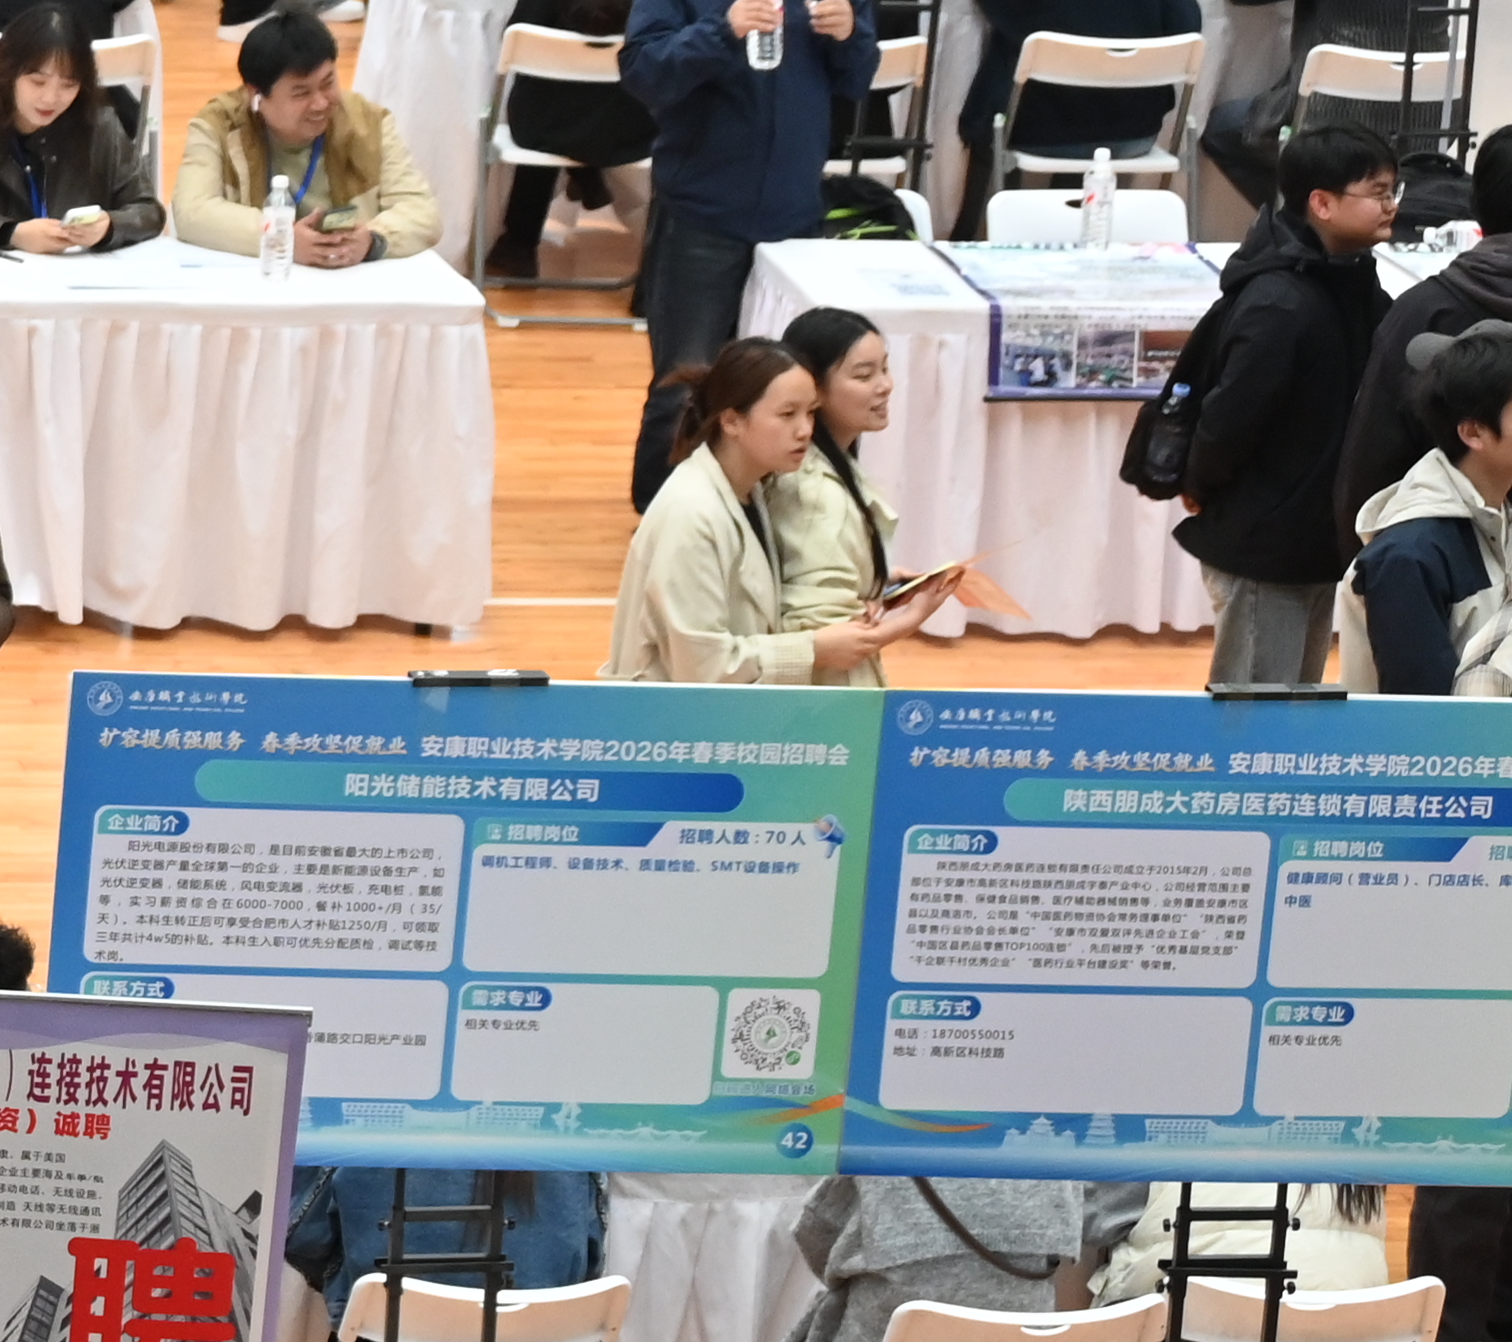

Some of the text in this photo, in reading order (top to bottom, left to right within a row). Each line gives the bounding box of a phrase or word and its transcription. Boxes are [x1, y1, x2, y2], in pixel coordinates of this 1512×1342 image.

[98, 727, 851, 768] 扩容提质强服务 安康职业技术学院2026年春季校园招聘会
[1069, 749, 1216, 774] 春季攻坚促就业
[344, 773, 602, 803] 阳光储能技术有限公司
[1063, 790, 1494, 820] 陕西朋成大药房医药连锁有限责任公司
[106, 812, 181, 833] 企业简介
[507, 822, 580, 844] 招聘岗位
[917, 833, 989, 853] 企业简介
[1312, 839, 1385, 859] 招聘岗位
[481, 853, 801, 876] 调机工程师、设备技术、质量检验、SMT设备操作
[1284, 894, 1312, 909] 中医
[471, 988, 544, 1009] 需求专业
[899, 998, 972, 1018] 联系方式
[1275, 1004, 1347, 1024] 需求专业
[464, 1017, 540, 1034] 相关专业优先
[1267, 1033, 1343, 1048] 相关专业优先
[893, 1044, 1006, 1060] 地址：高新区科技路
[781, 1132, 808, 1151] 42
